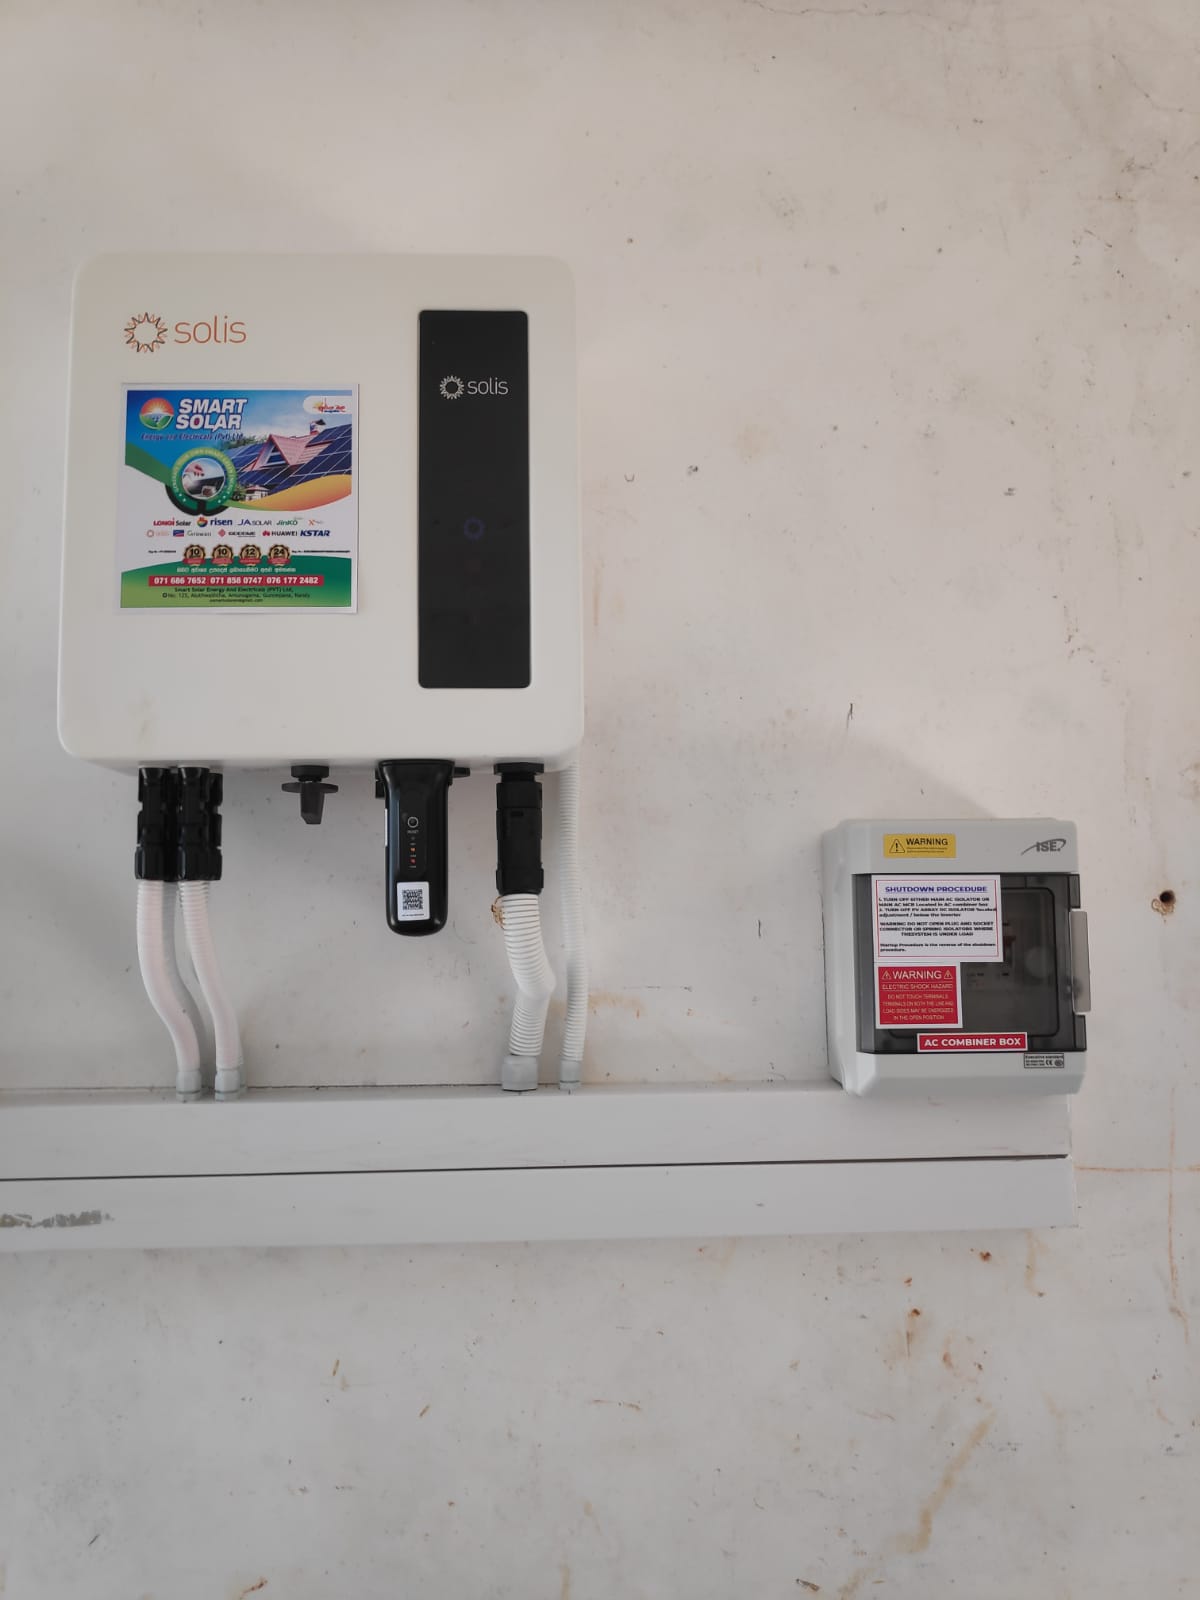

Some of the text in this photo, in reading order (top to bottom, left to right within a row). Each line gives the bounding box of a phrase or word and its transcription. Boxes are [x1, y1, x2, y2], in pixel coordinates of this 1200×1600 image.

[174, 315, 247, 344] solis
[467, 377, 509, 395] solis
[179, 399, 248, 414] SMART
[176, 414, 242, 430] SOLAR
[210, 517, 233, 526] risen
[190, 547, 200, 555] 10
[217, 547, 228, 555] 10
[245, 547, 256, 555] 12
[273, 547, 284, 555] 24
[154, 577, 168, 585] 071
[187, 577, 206, 585] 7652
[210, 577, 224, 585] 071
[243, 577, 263, 585] 0747
[266, 577, 281, 585] 076
[283, 577, 297, 585] 177
[299, 577, 319, 585] 2482
[906, 837, 949, 846] WARNING
[892, 970, 942, 979] WARNING
[924, 1038, 1021, 1047] AC COMBINER BOX
